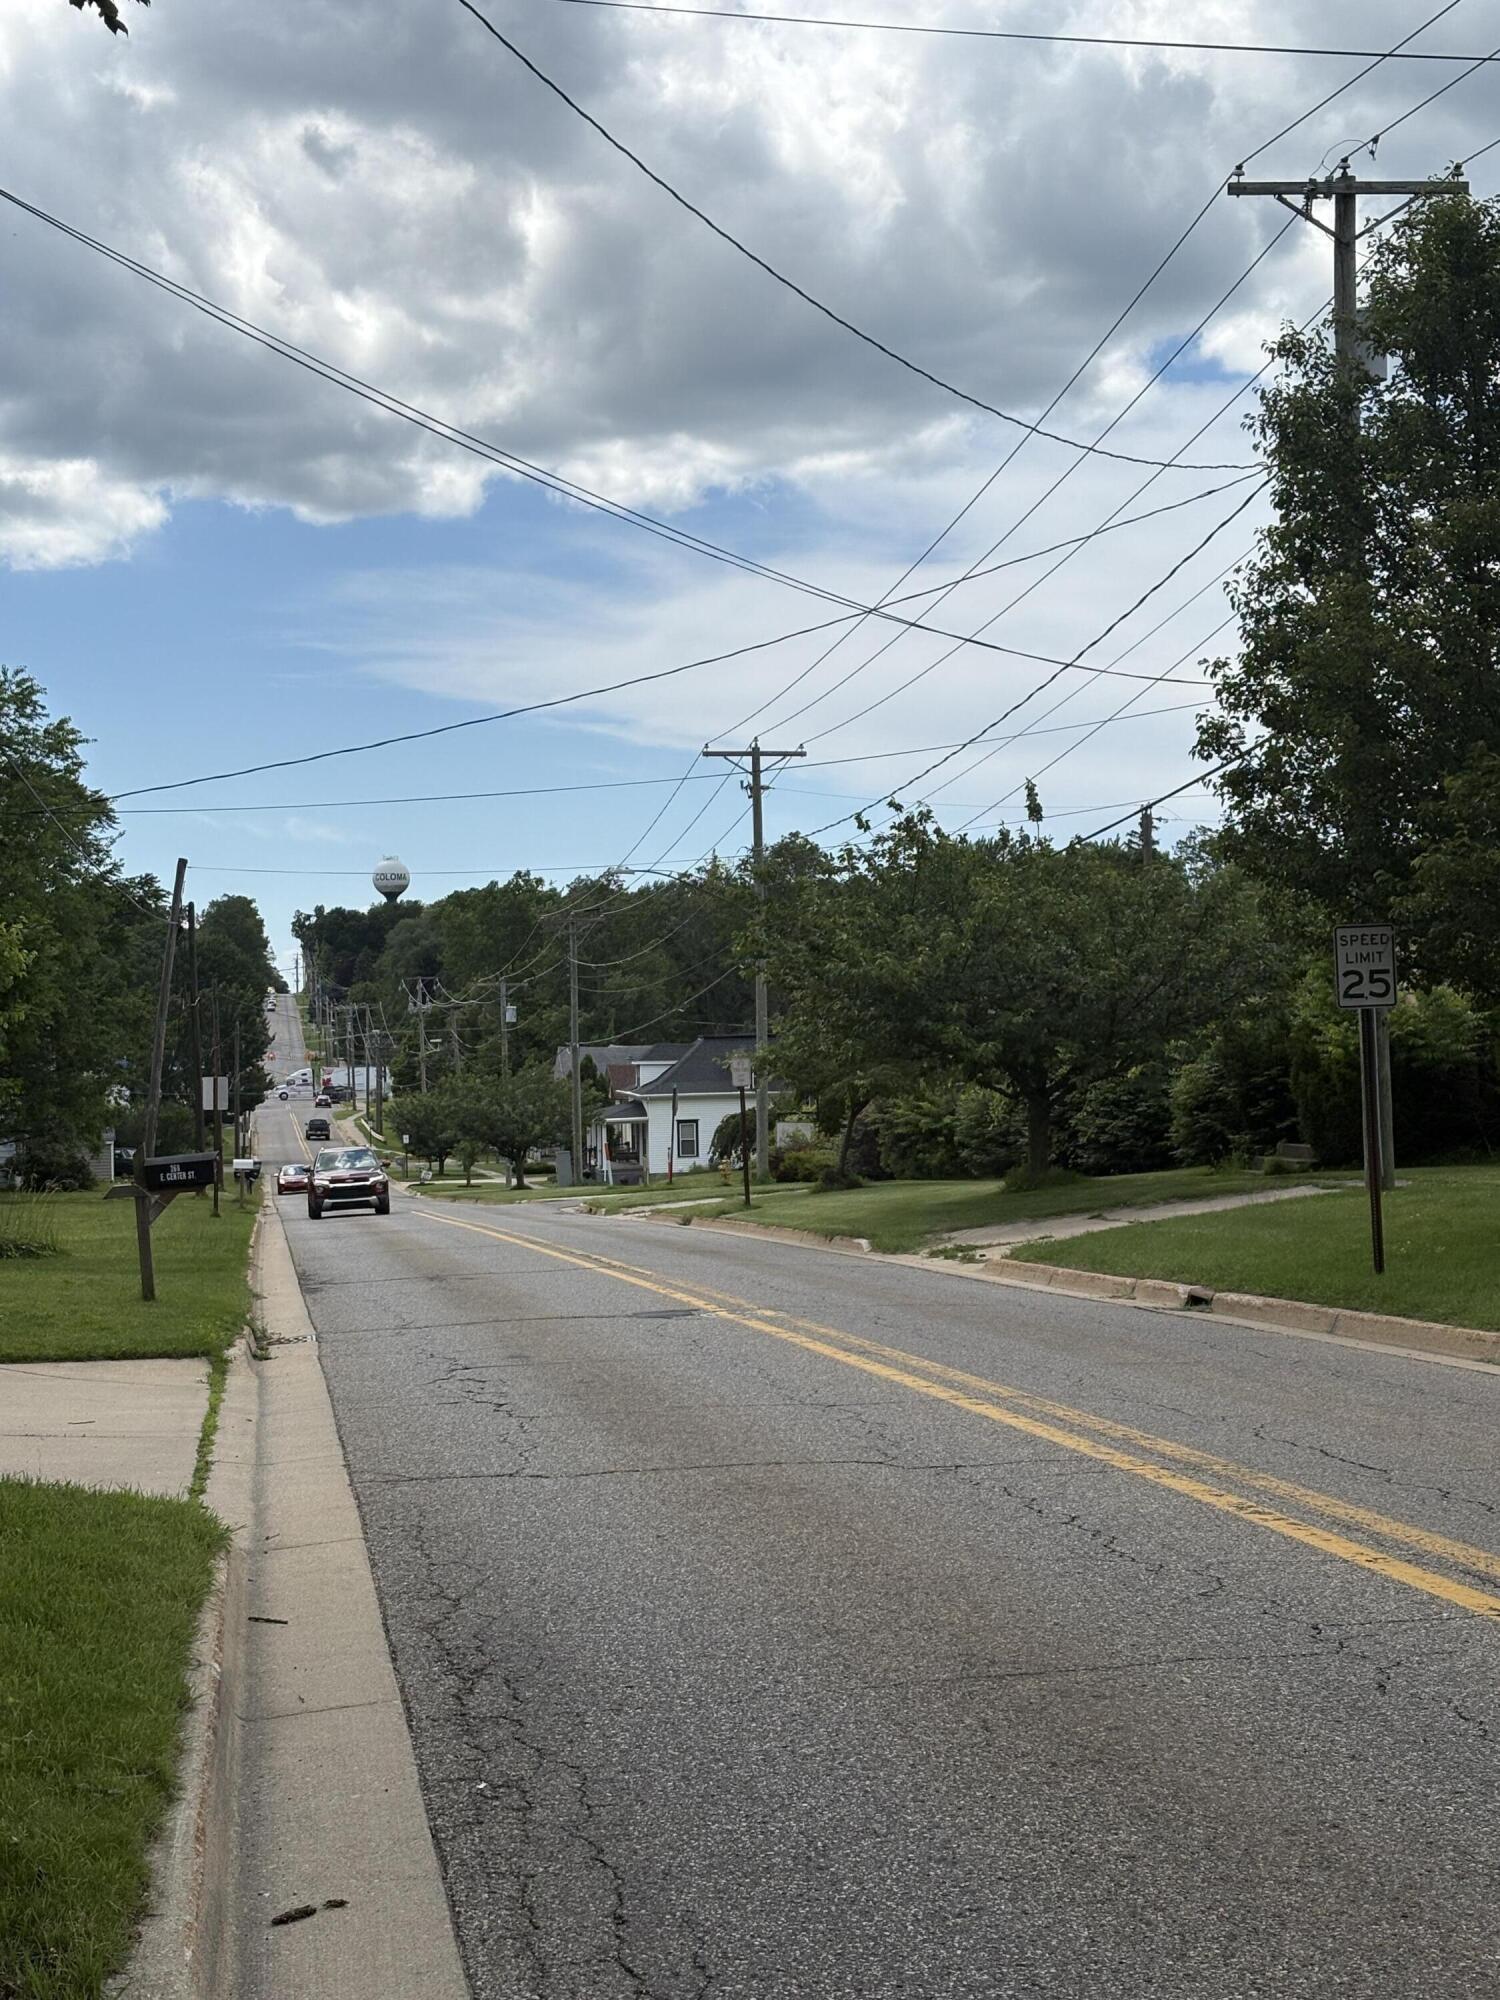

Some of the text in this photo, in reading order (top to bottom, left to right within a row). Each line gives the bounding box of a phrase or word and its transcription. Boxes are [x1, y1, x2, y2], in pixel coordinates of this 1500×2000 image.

[375, 872, 406, 881] COLOMA
[1340, 933, 1390, 946] SPEED
[1345, 951, 1384, 964] LIMIT
[1342, 969, 1391, 998] 25
[166, 1171, 186, 1181] CENTER
